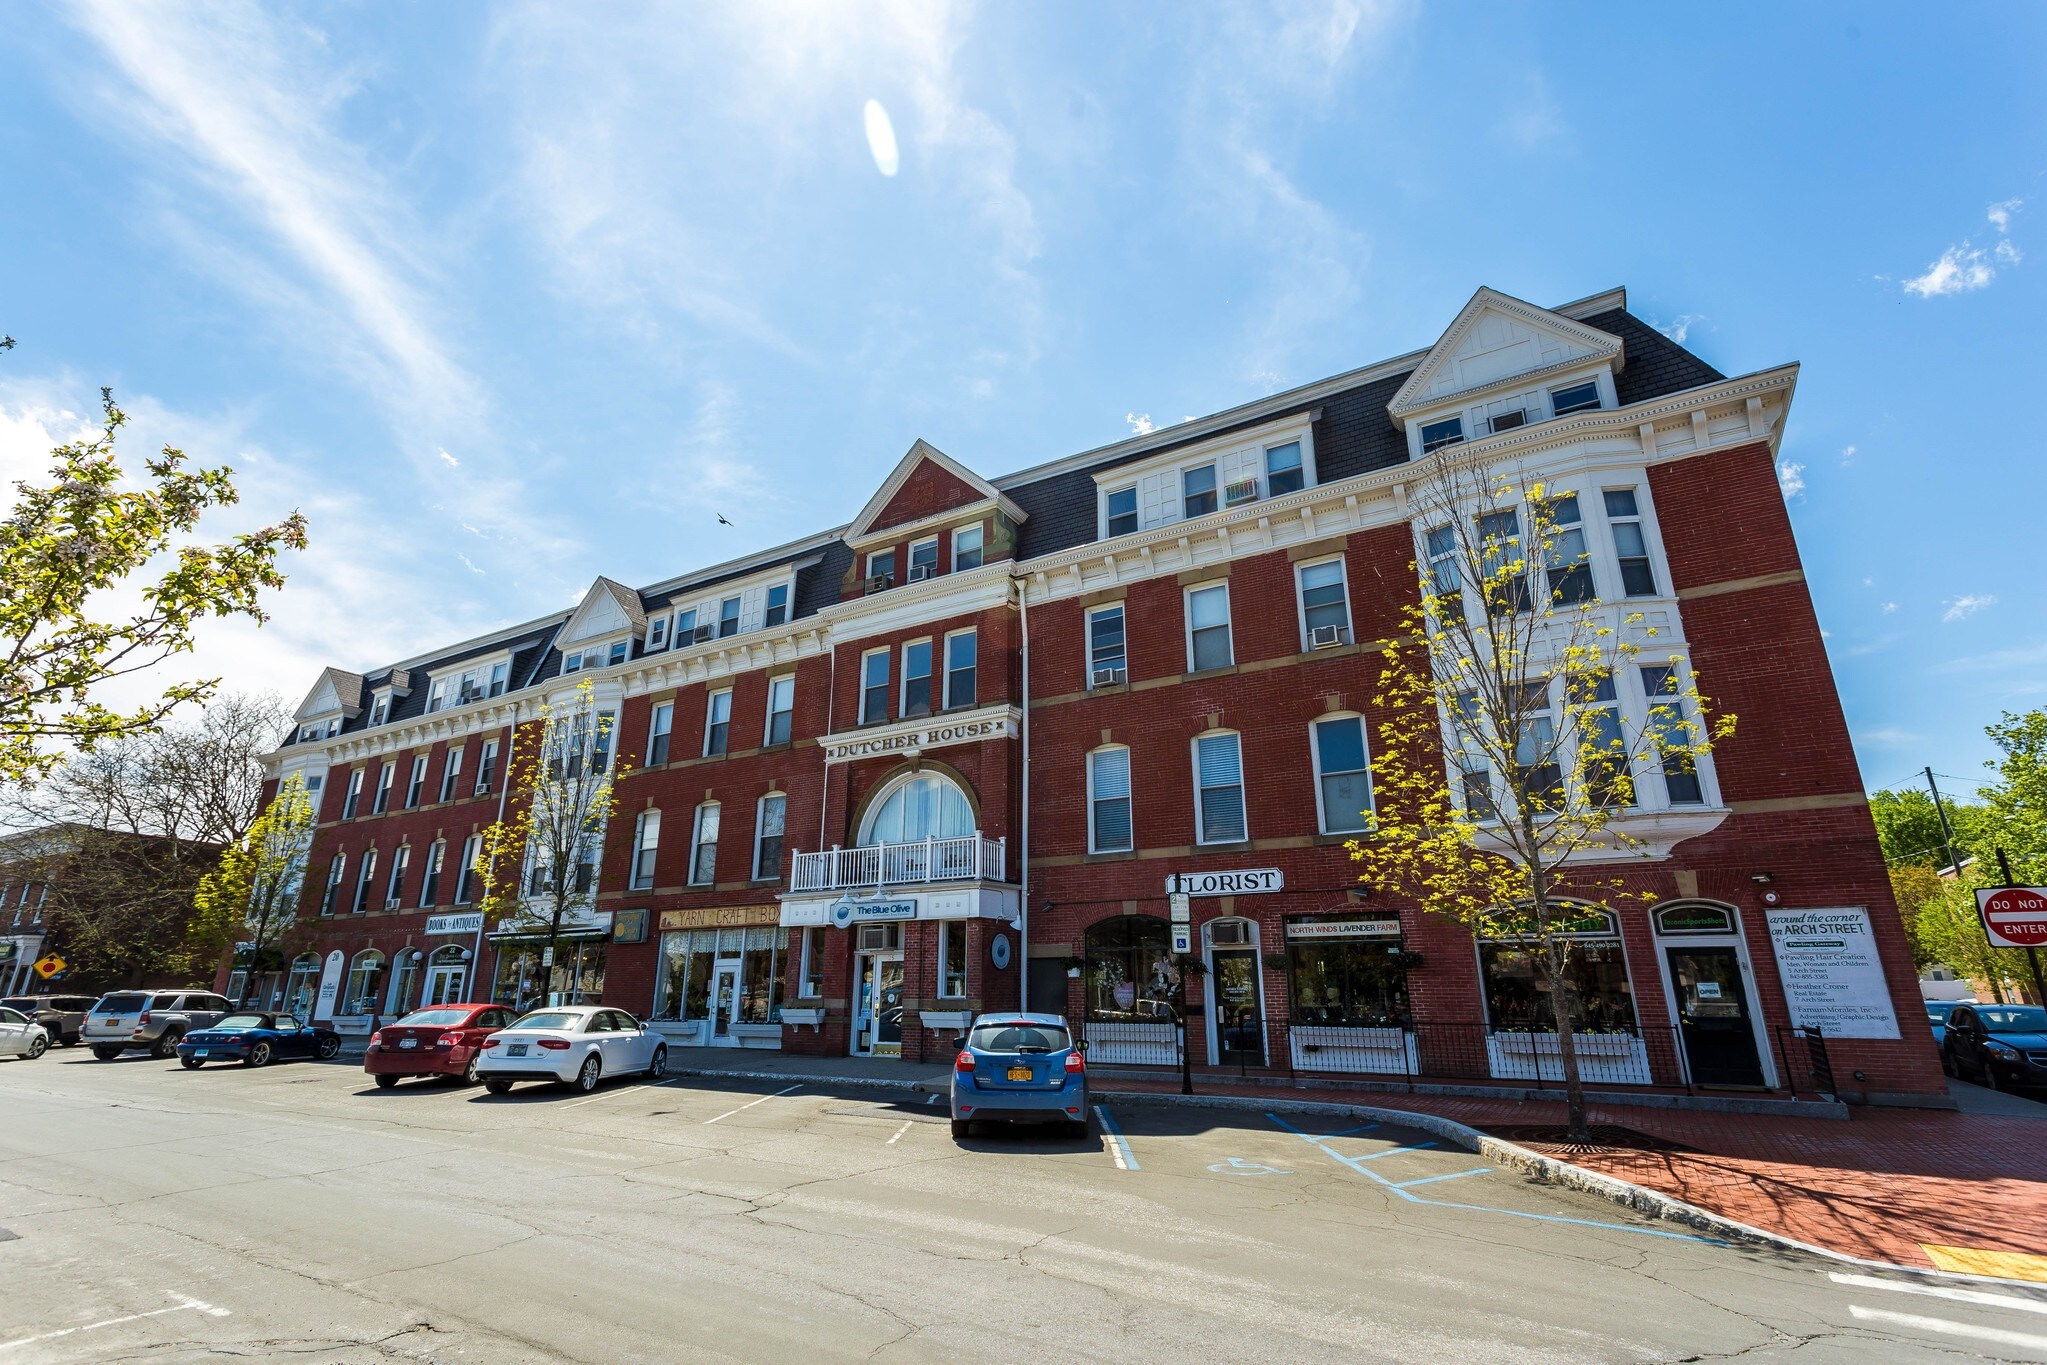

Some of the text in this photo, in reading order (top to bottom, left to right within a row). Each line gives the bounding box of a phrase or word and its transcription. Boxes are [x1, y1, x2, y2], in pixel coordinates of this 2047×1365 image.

[836, 721, 993, 758] DUTCHER HOUSE
[856, 904, 910, 914] The Blue Olive
[1992, 900, 2044, 910] DO NOT
[679, 910, 706, 926] YARN
[716, 908, 750, 924] CRAFT
[1770, 913, 1861, 923] around the corner
[428, 918, 447, 930] BOOKS
[451, 917, 480, 930] ANTIQUES
[1339, 924, 1376, 932] LAVENDER
[1785, 924, 1817, 935] ARCH
[2004, 924, 2046, 934] ENTER
[332, 953, 339, 961] 20
